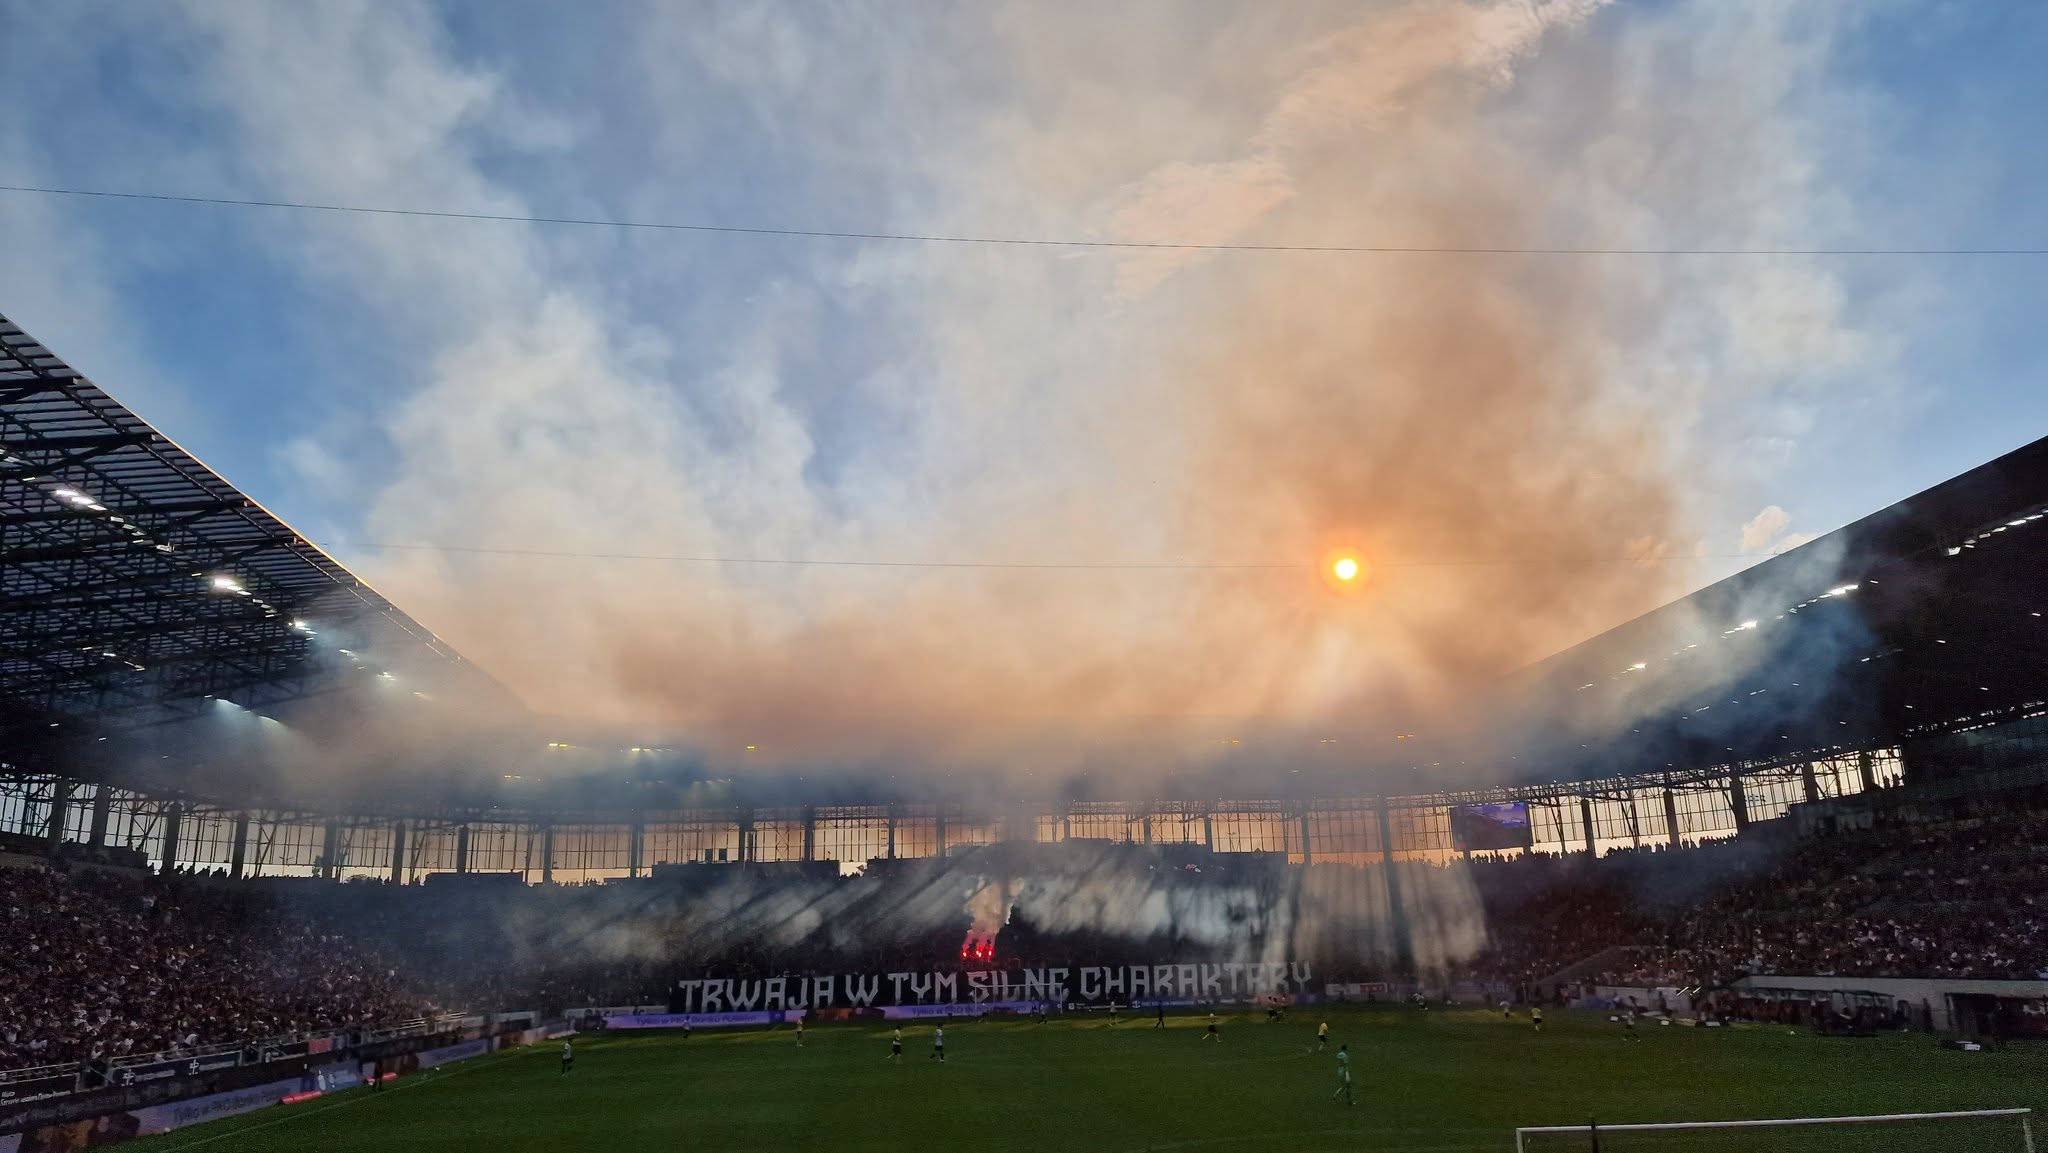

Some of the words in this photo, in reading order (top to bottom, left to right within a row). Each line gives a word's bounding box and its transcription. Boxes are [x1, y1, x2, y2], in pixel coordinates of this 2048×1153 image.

[678, 977, 835, 1013] TRWAJA
[845, 974, 879, 1008] W
[887, 971, 958, 1006] TYM
[966, 967, 1071, 1004] SILNE
